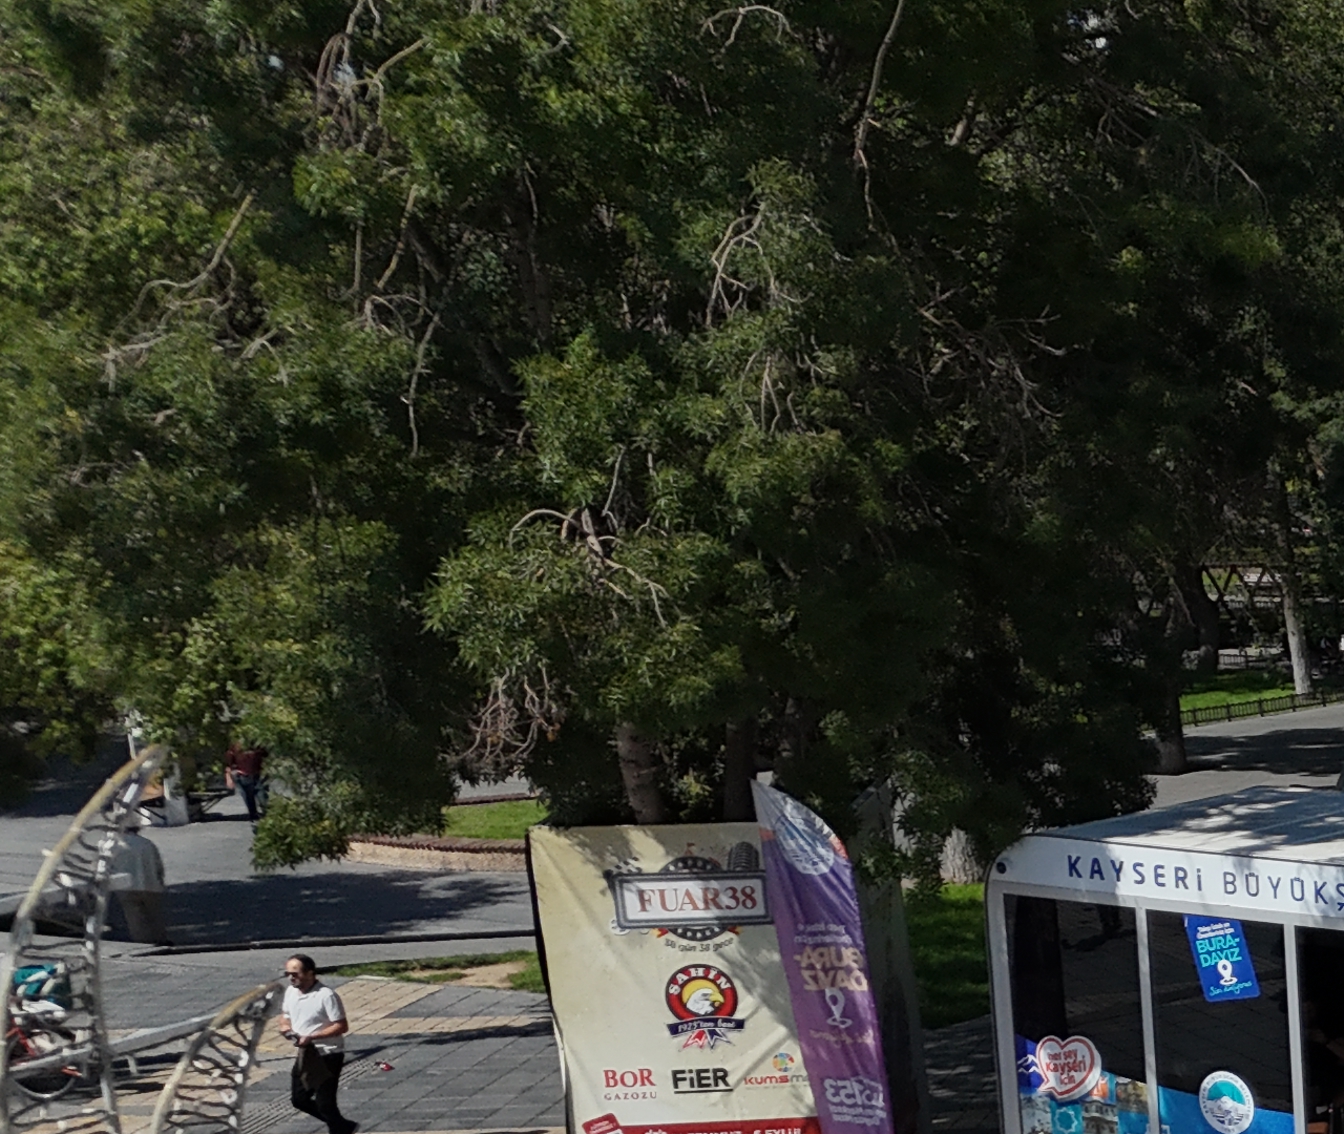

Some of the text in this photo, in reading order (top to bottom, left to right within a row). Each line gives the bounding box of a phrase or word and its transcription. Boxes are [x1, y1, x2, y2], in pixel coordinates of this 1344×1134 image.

[637, 886, 757, 912] FUAR38
[1196, 934, 1240, 953] BURA-
[604, 1091, 657, 1100] GAZOZU
